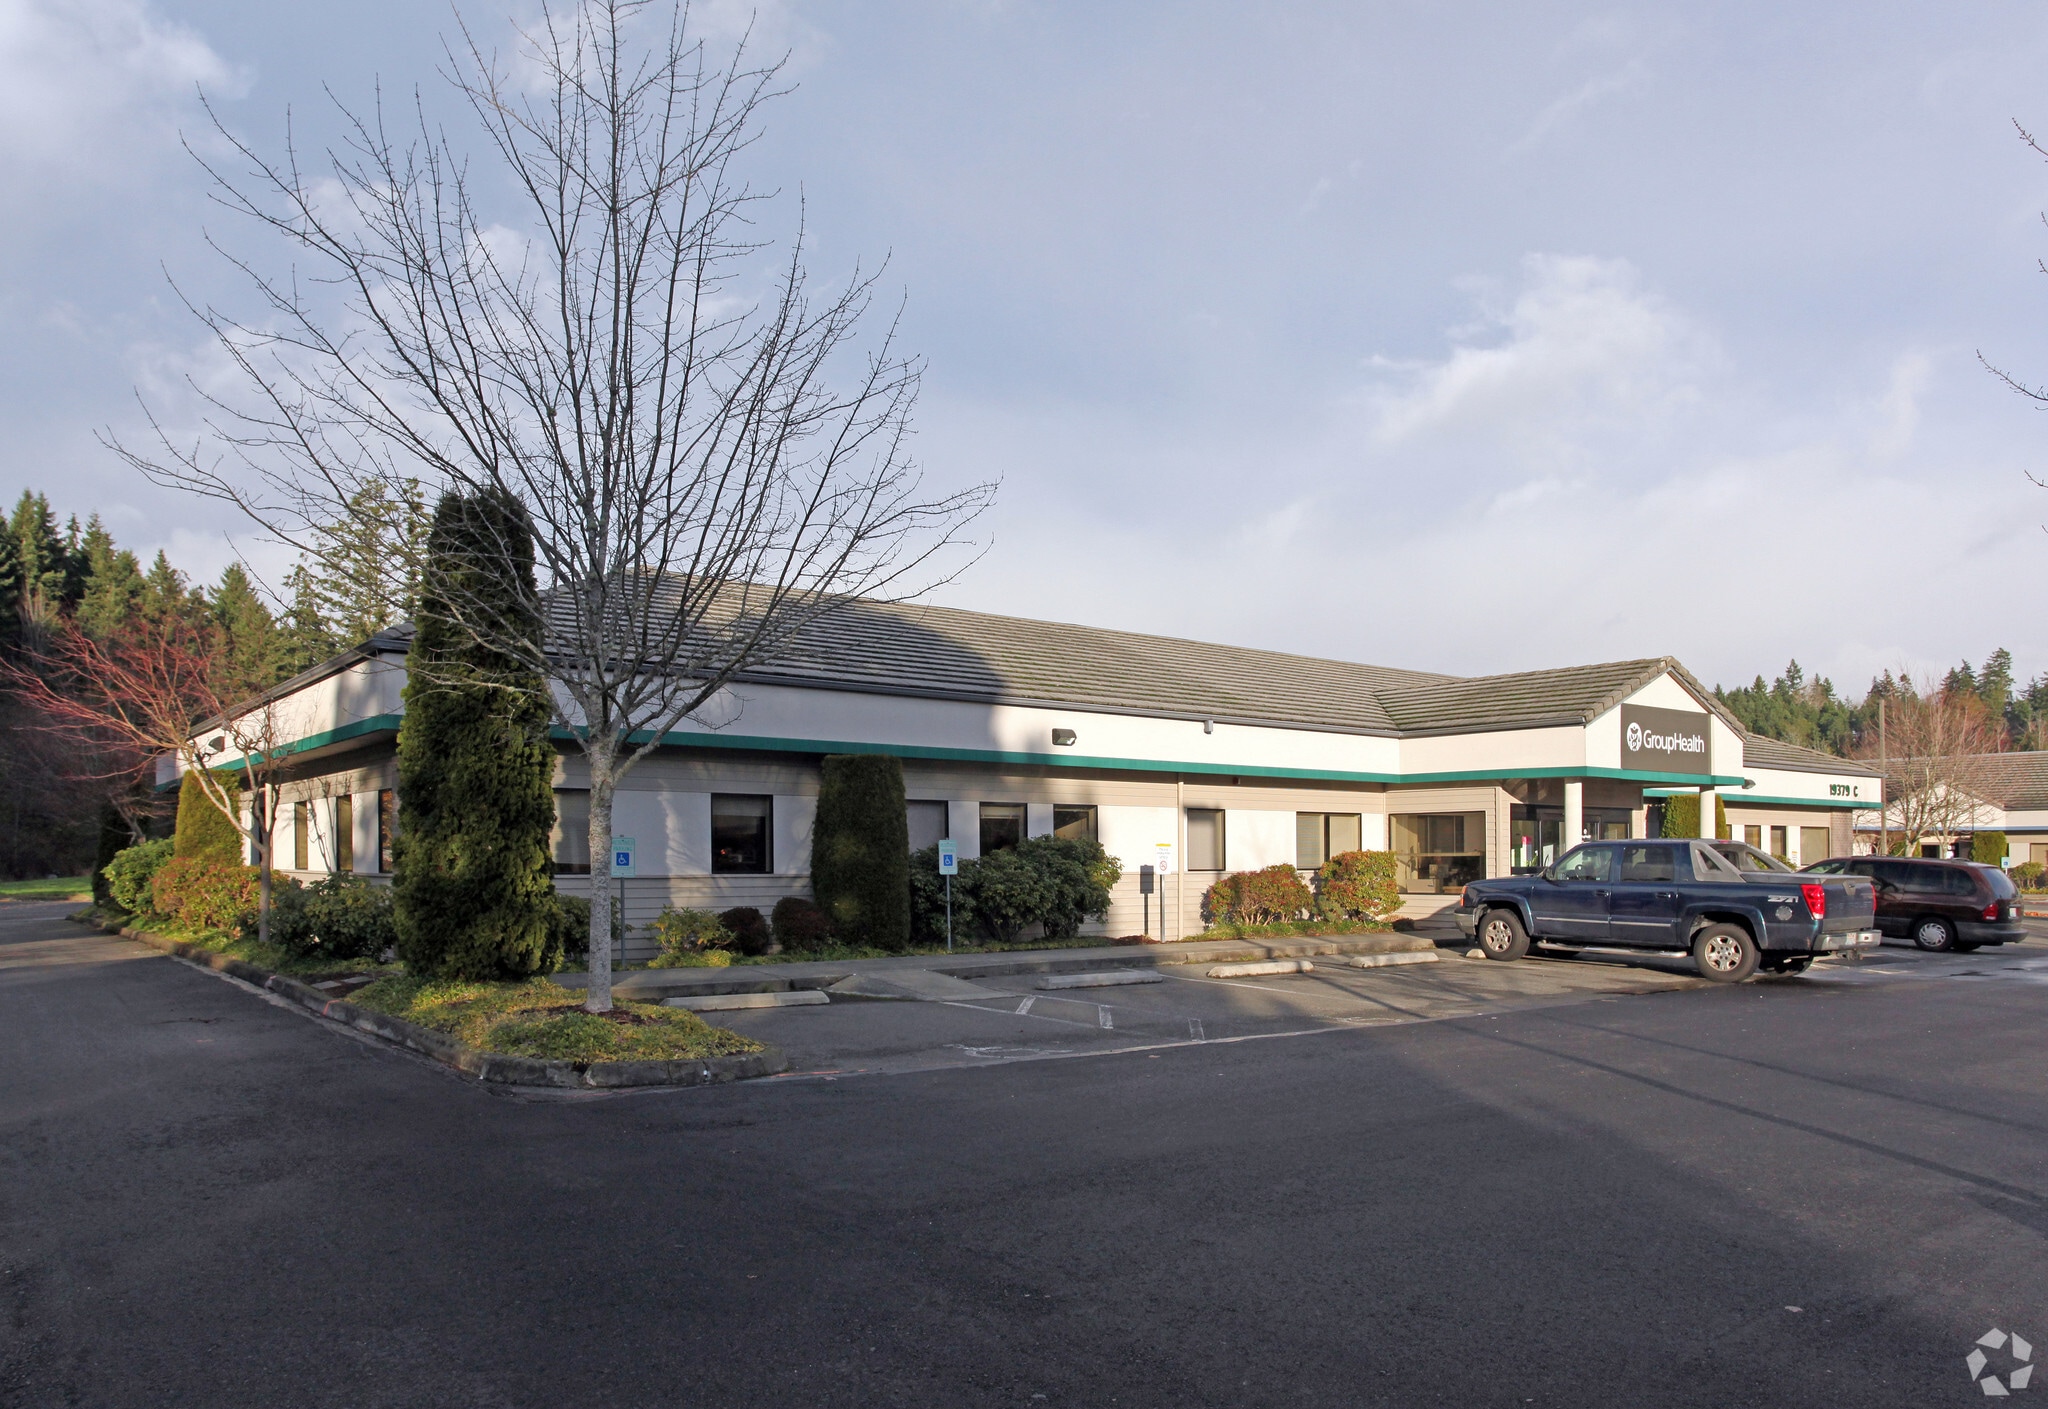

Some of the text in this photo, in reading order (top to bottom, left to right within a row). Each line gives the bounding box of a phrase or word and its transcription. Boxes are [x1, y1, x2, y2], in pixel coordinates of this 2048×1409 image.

[1643, 729, 1705, 754] GroupHealth
[1829, 784, 1858, 797] 19379 C
